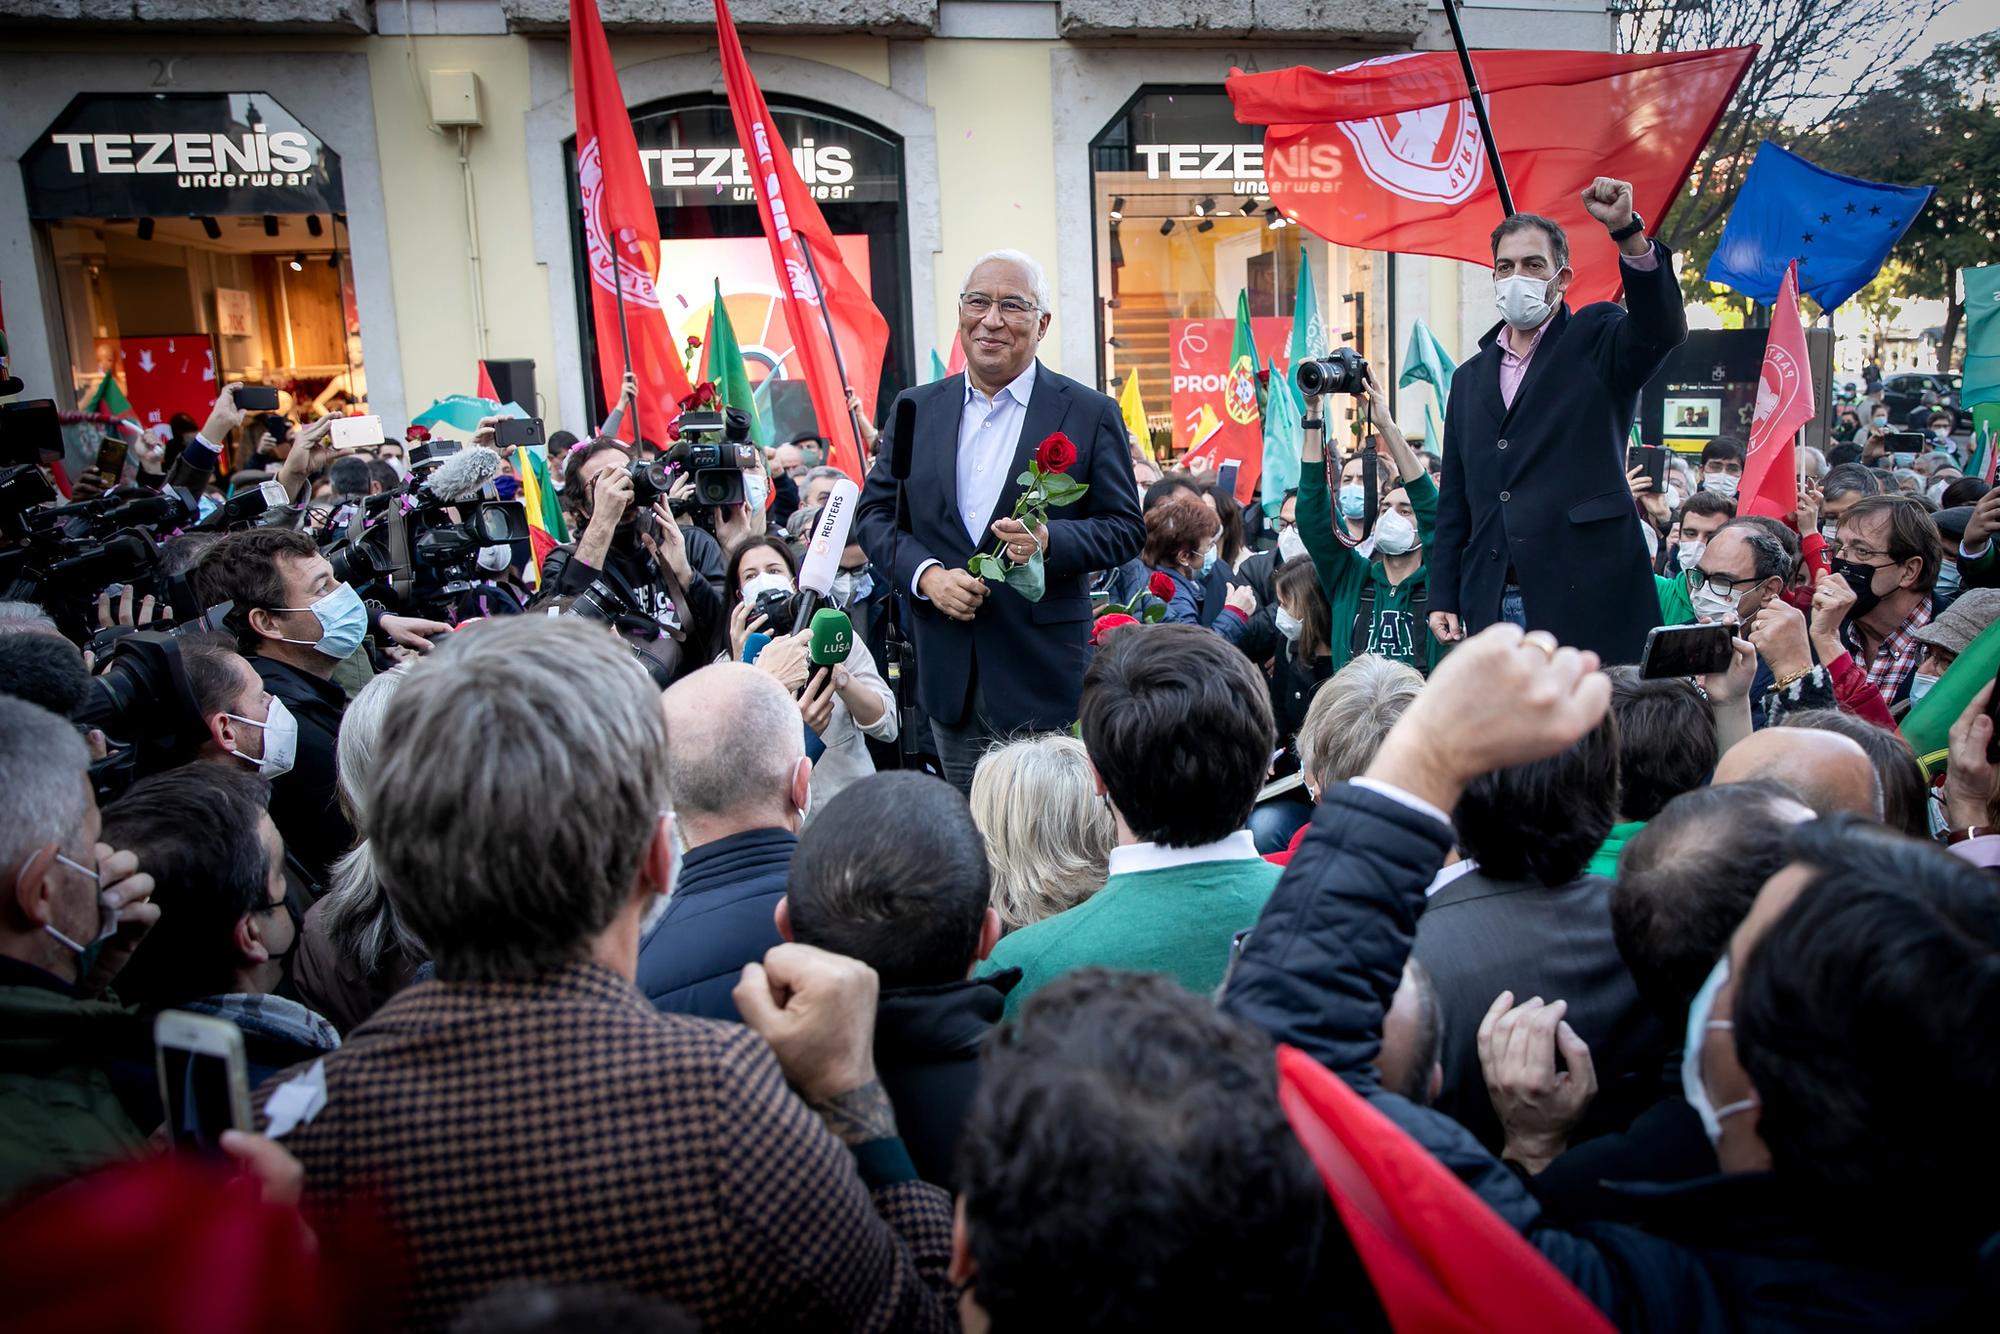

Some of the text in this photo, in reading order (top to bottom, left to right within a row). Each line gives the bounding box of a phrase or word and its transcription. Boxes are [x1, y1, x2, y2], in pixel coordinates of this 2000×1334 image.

[178, 171, 313, 188] underwear
[821, 495, 844, 538] REUTERS
[823, 642, 851, 654] LUSA
